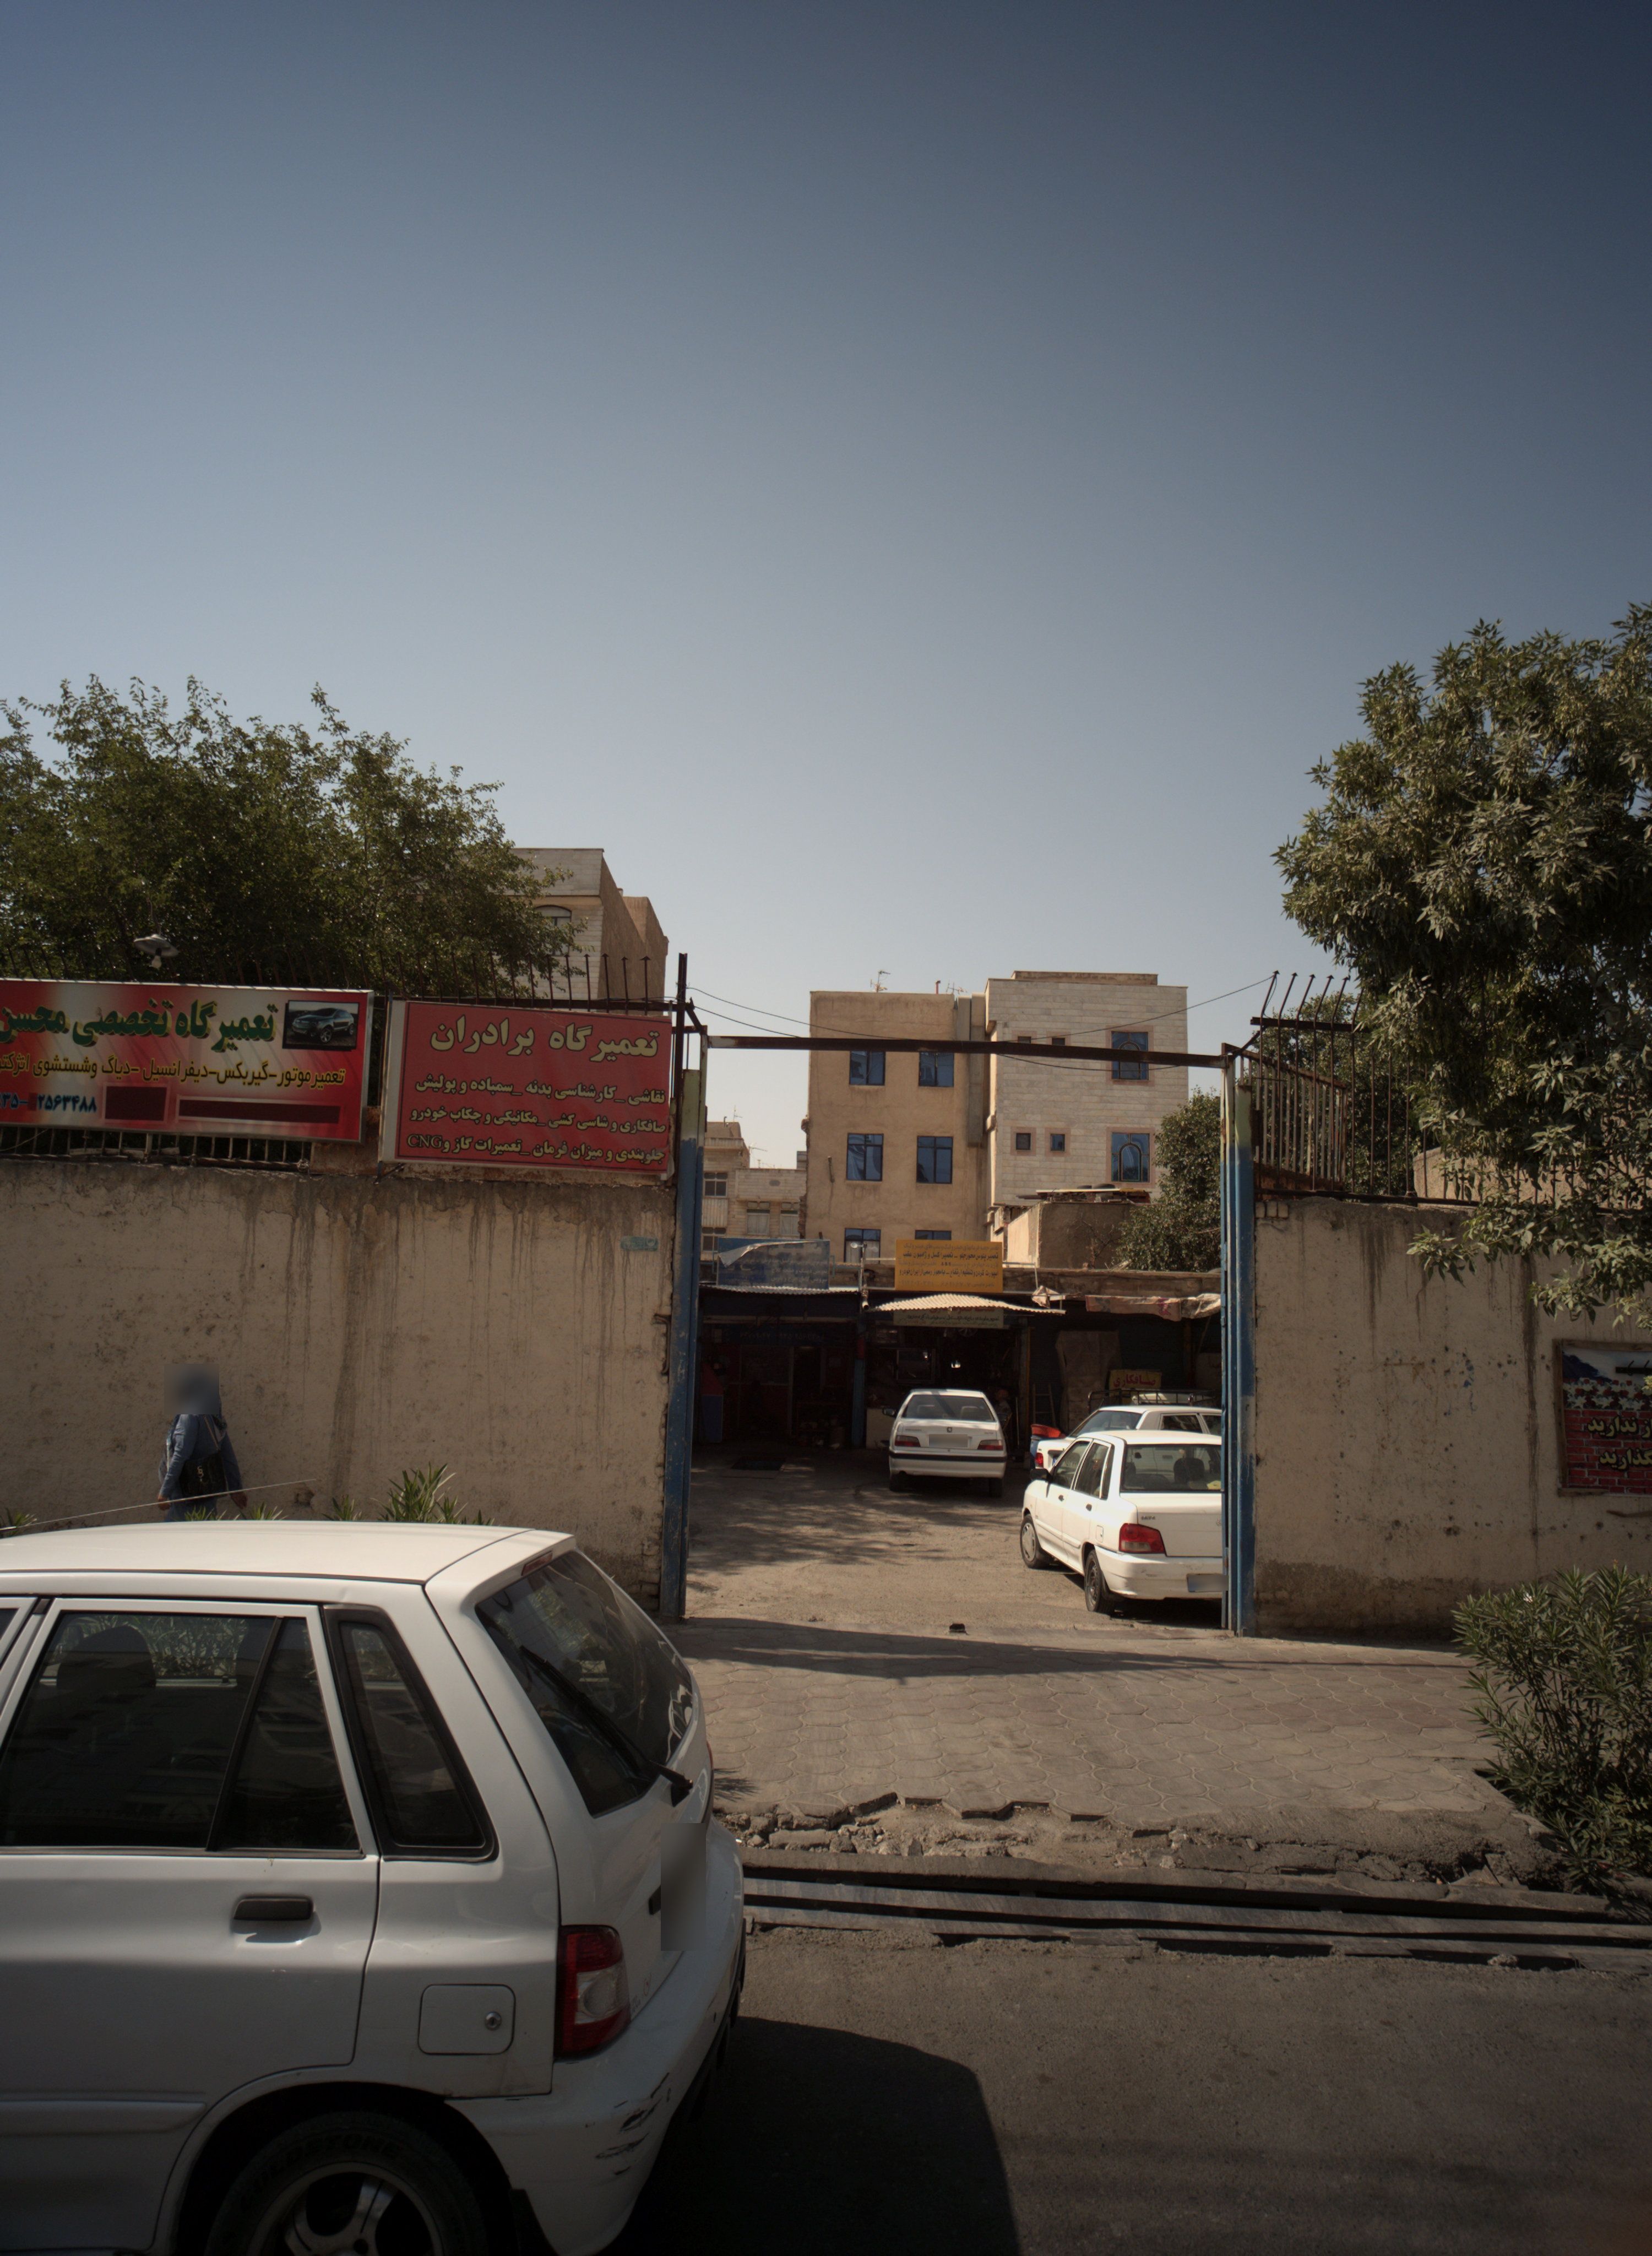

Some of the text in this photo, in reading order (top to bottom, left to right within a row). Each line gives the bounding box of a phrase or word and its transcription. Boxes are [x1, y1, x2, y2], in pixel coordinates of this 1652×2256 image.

[0, 1005, 70, 1043] محسن
[72, 998, 175, 1046] تخصصی
[430, 1014, 535, 1056] برادران
[311, 1069, 346, 1090] تعمیر
[415, 1073, 457, 1094] پولیش
[458, 1081, 467, 1094] و
[525, 1080, 552, 1099] بدنه
[628, 1089, 666, 1105] نقاشی
[410, 1105, 448, 1122] خودرو
[449, 1107, 482, 1125] چکاب
[483, 1113, 492, 1125] و
[548, 1113, 576, 1129] کشی
[577, 1115, 608, 1130] شاسی
[610, 1121, 618, 1132] و
[620, 1119, 666, 1134] صافکاری
[532, 1140, 568, 1159] فرمان
[569, 1142, 604, 1161] میزان
[605, 1149, 613, 1162] و
[615, 1148, 665, 1165] جلوبندی
[1113, 1374, 1156, 1387] صافکاری
[1587, 1416, 1638, 1439] ندارید
